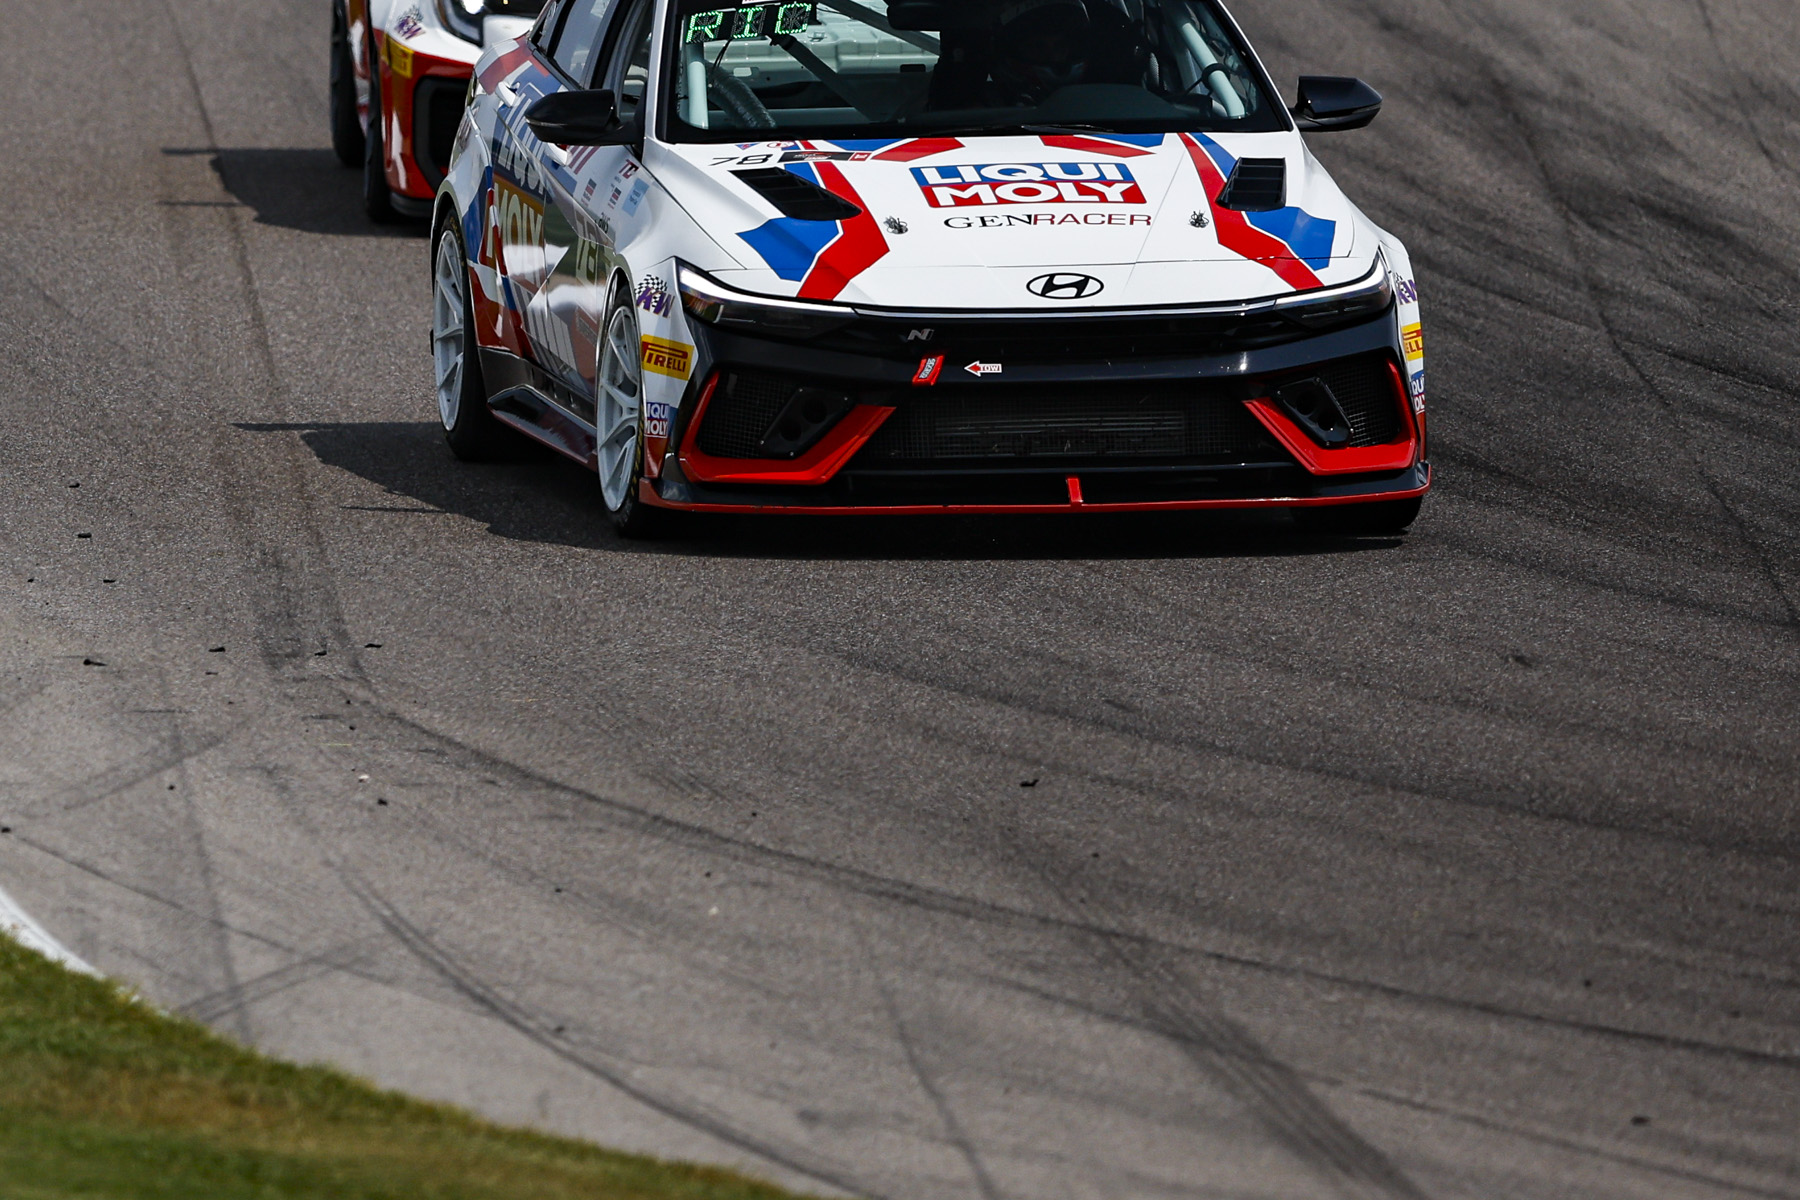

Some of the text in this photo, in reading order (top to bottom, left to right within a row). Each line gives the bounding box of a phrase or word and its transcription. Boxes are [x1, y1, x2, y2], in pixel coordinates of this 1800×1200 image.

[686, 1, 812, 43] RIC
[708, 153, 774, 166] 78
[919, 162, 1125, 184] LIQUI
[931, 181, 1136, 207] MOLY
[943, 213, 1152, 230] GENRACER
[637, 287, 676, 318] KW
[642, 341, 689, 373] PIRELLI
